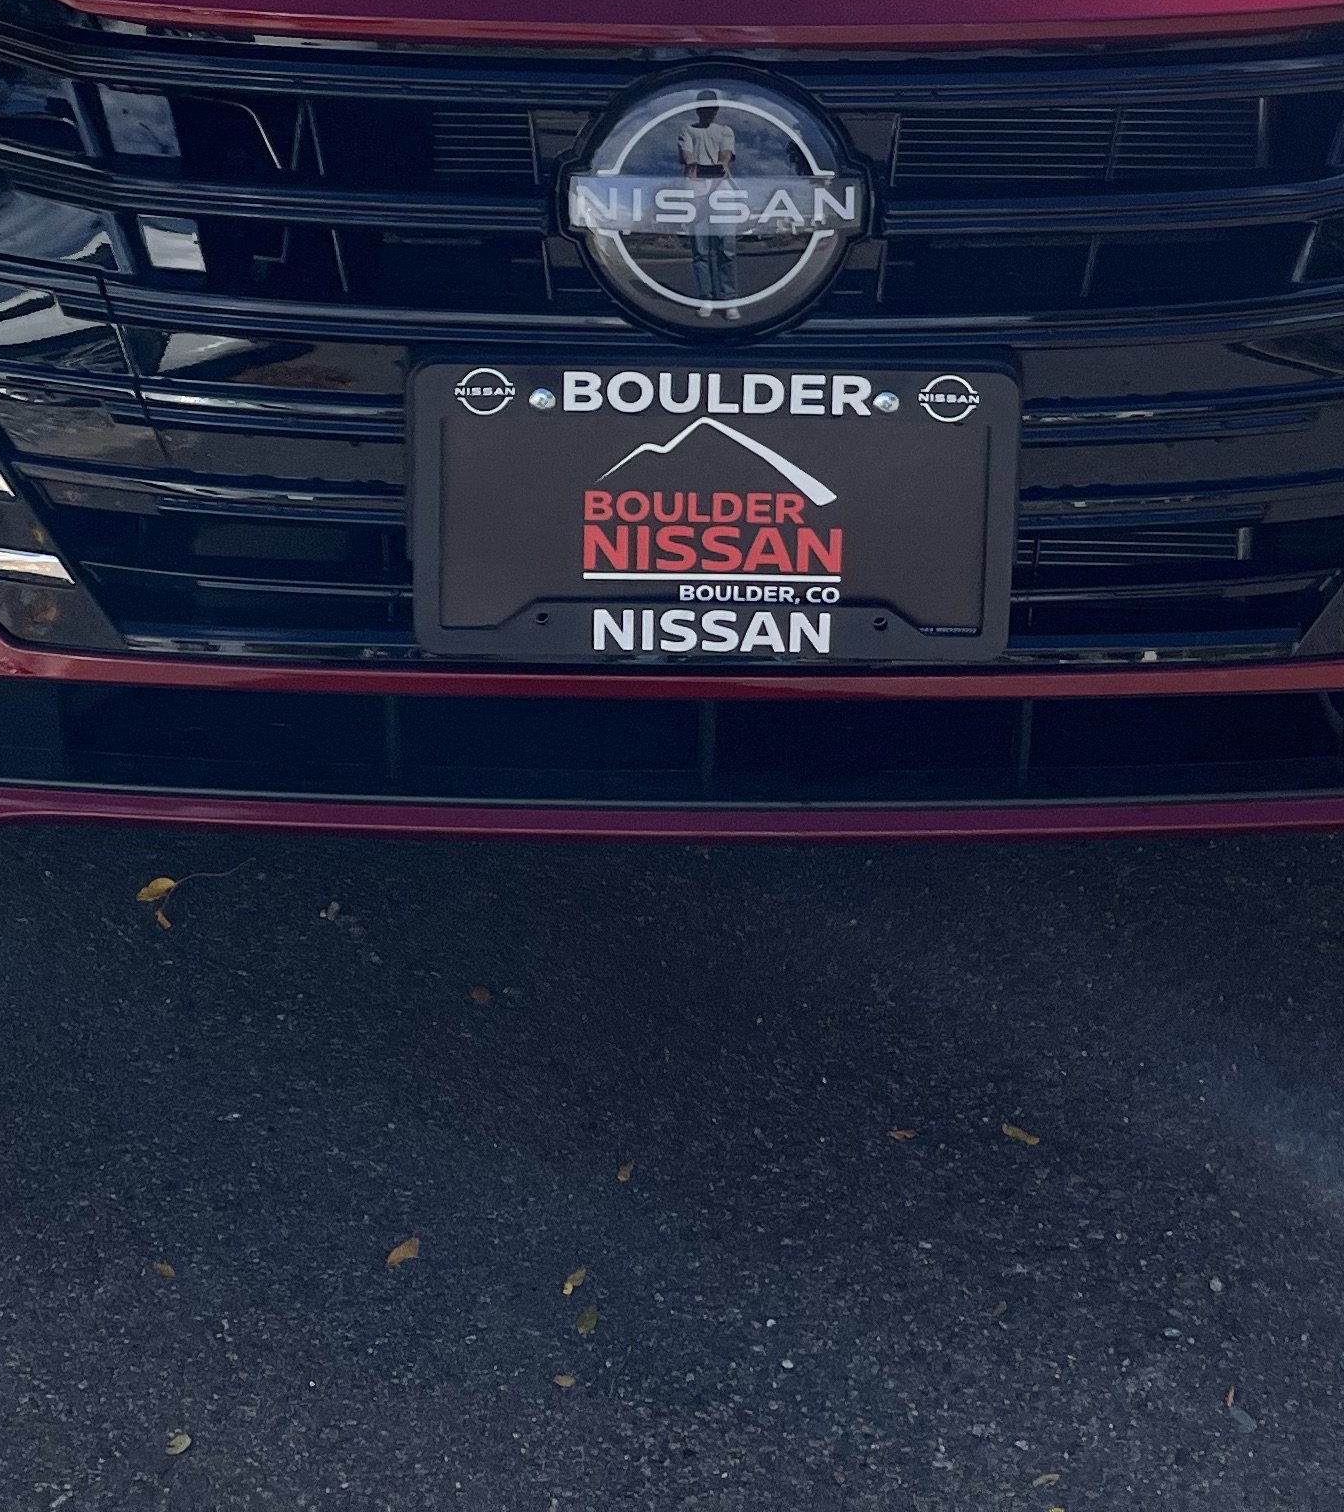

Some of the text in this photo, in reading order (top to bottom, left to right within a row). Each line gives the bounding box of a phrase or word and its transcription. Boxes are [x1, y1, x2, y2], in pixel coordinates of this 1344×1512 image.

[575, 186, 855, 224] NISSAN
[454, 371, 980, 416] NISSAN BOULDER NISSAN
[584, 490, 805, 524] BOULDER
[583, 524, 843, 573] NISSAN
[679, 584, 841, 605] BOULDER, CO
[593, 608, 832, 654] NISSAN
